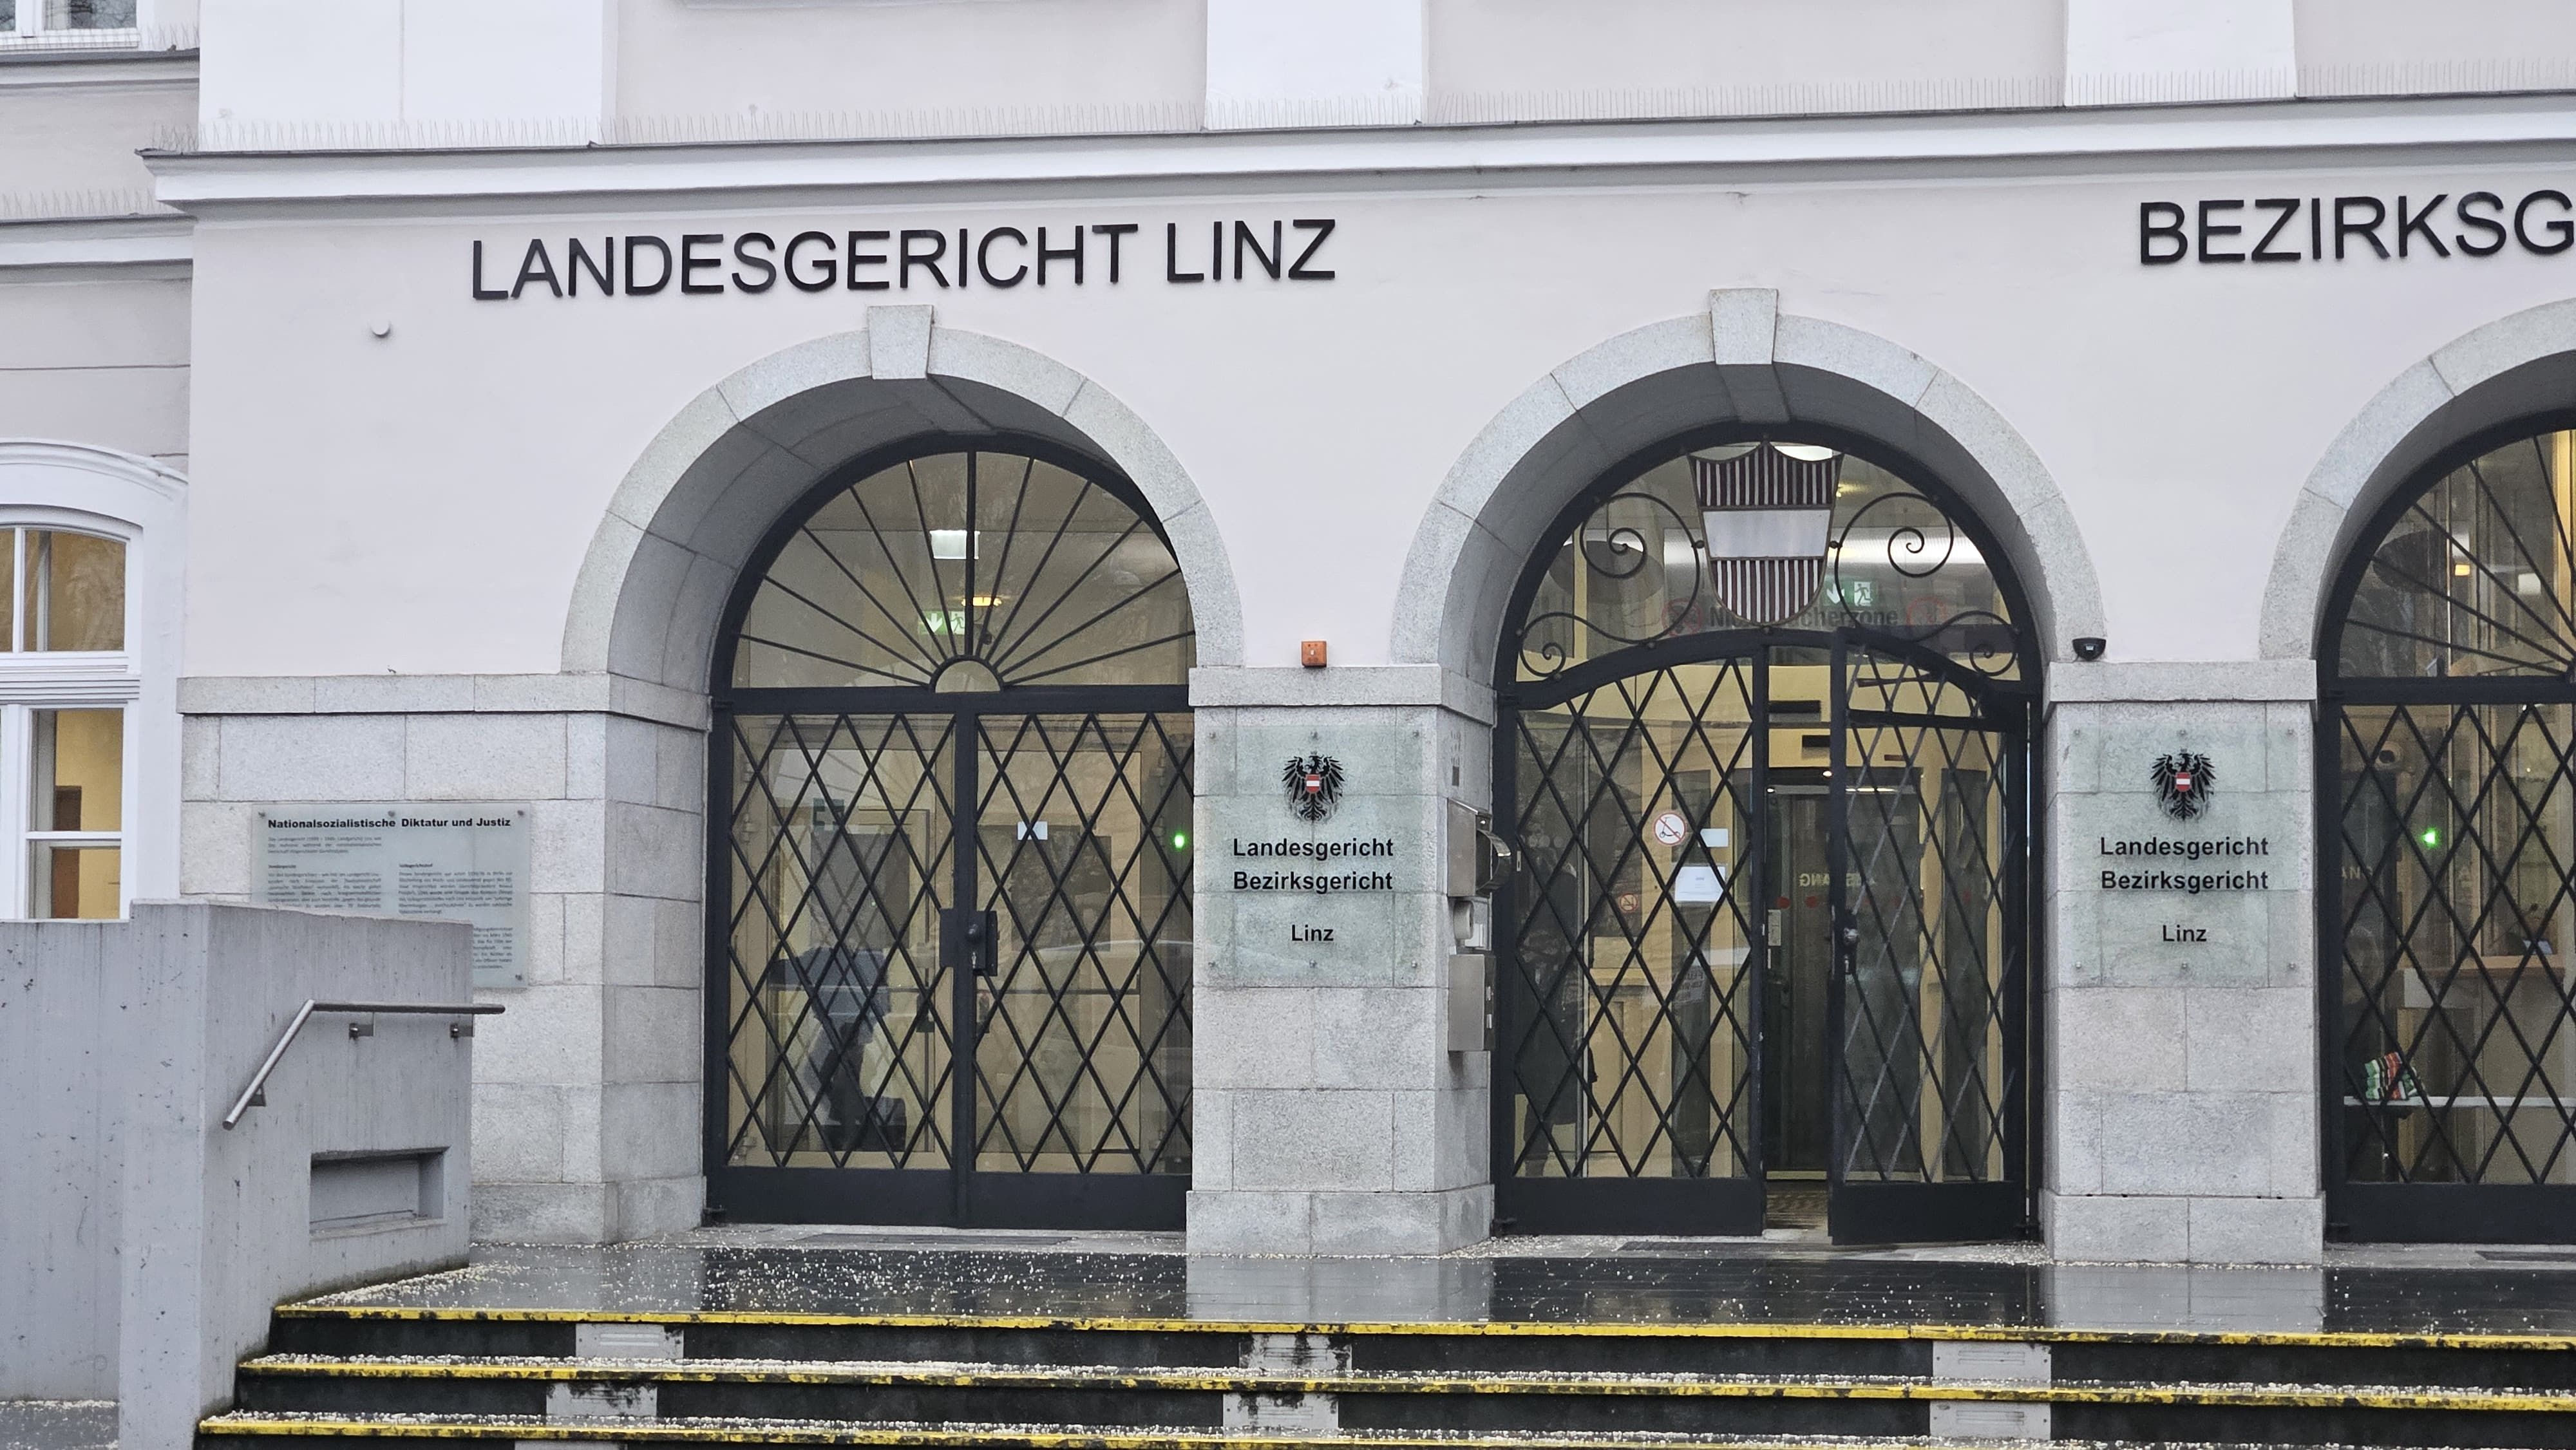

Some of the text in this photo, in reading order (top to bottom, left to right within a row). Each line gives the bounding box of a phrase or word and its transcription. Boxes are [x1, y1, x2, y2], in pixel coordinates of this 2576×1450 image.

[2140, 189, 2575, 266] BEZIRKSG
[473, 219, 1336, 301] LANDESGERICHT LINZ
[1709, 606, 1899, 627] Nicherzone
[268, 817, 511, 829] Nationalsozialistische Diktatur und Justiz
[1233, 838, 1394, 862] Landesgericht
[2101, 836, 2269, 861] Landesgericht
[1234, 871, 1393, 895] Bezirksgericht
[2101, 871, 2268, 895] Bezirksgericht
[1291, 924, 1334, 942] Linz
[2162, 925, 2208, 942] Linz
